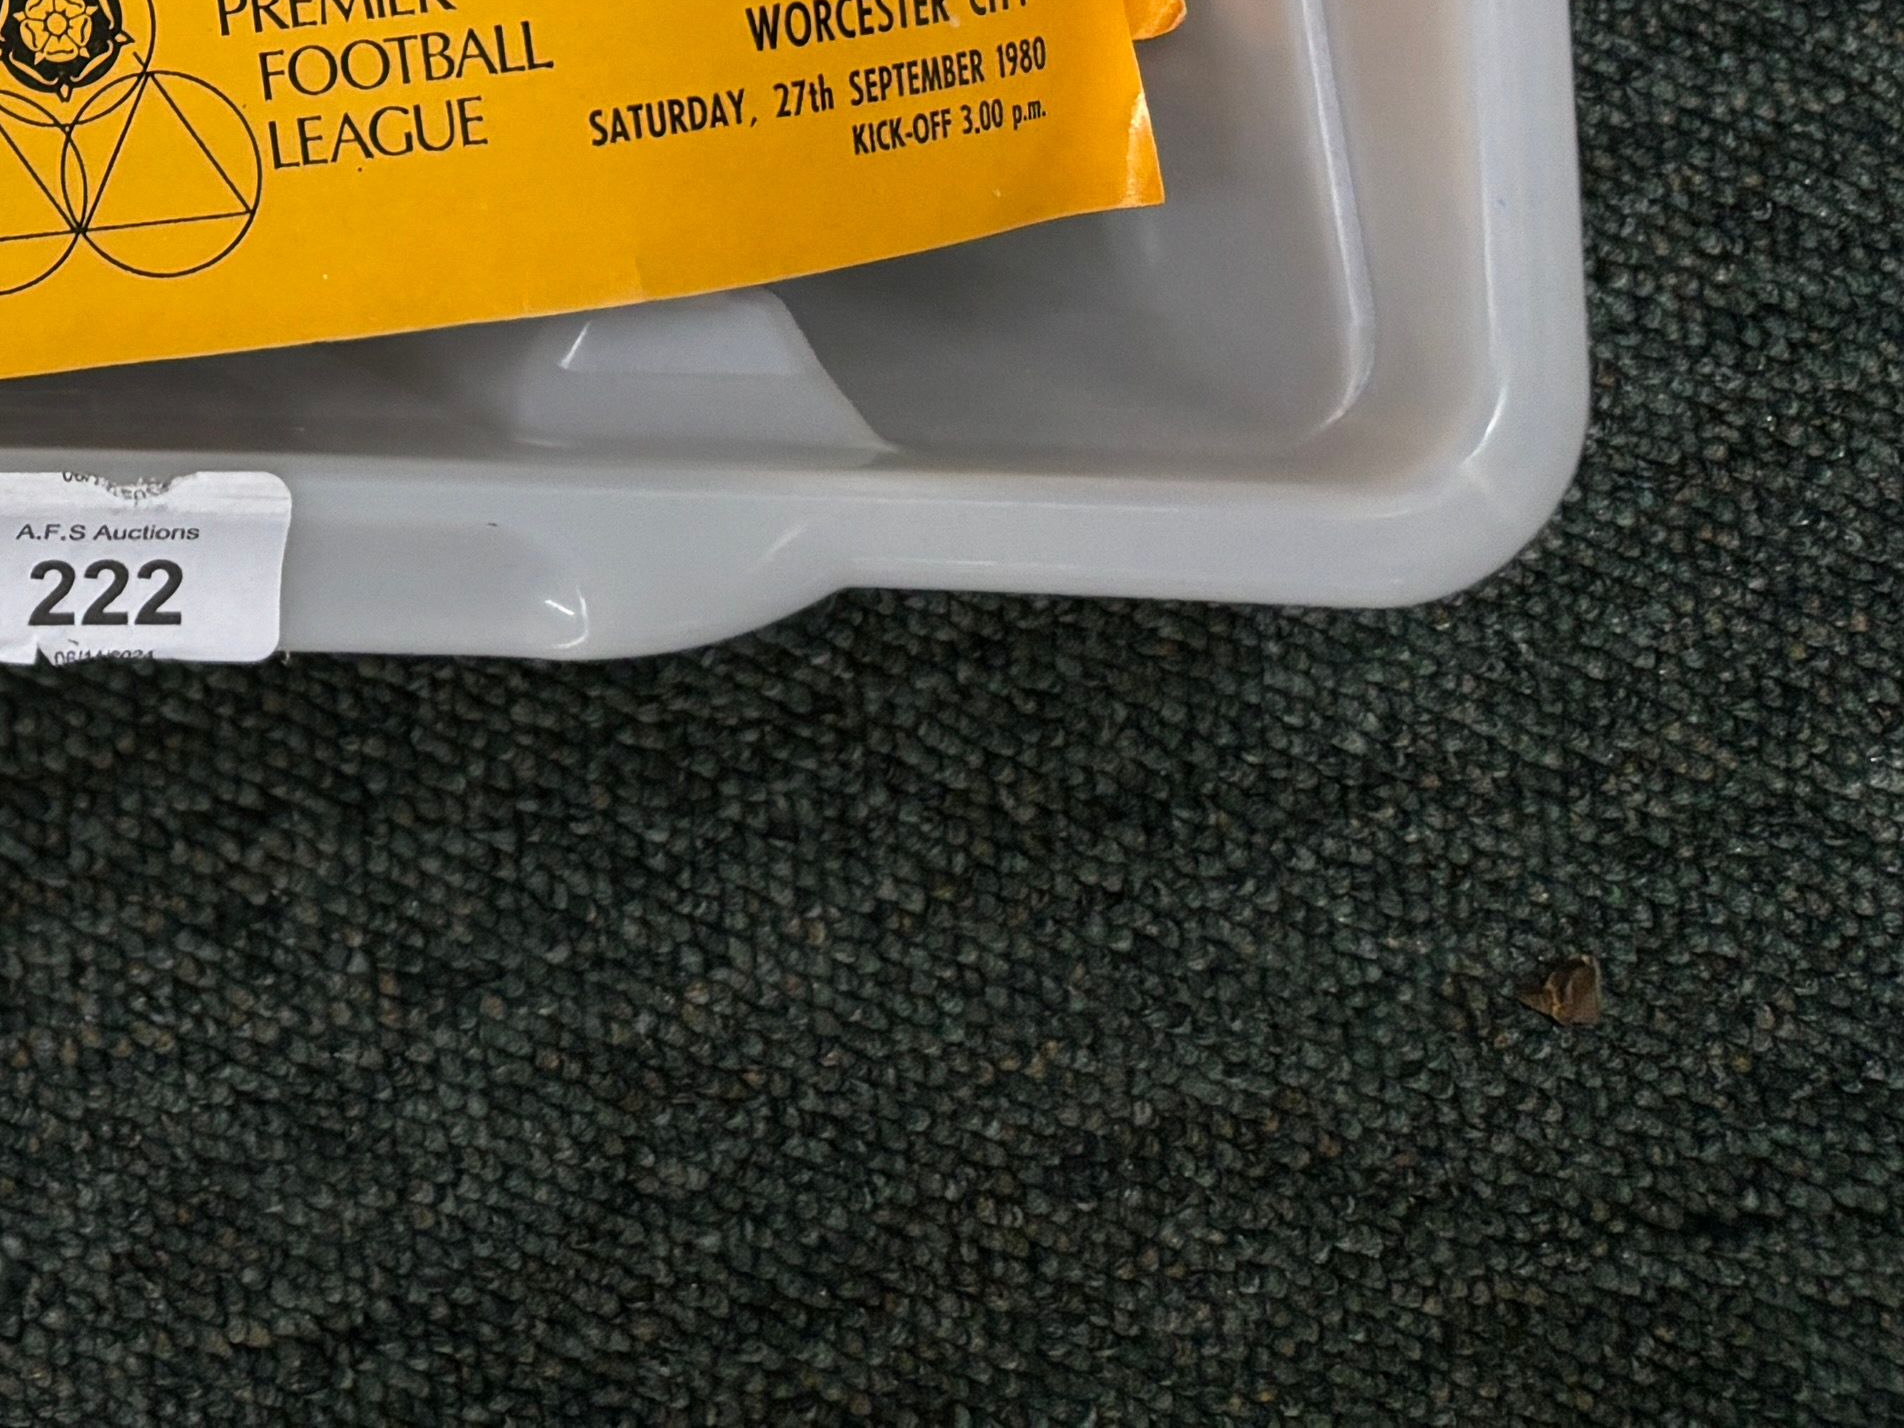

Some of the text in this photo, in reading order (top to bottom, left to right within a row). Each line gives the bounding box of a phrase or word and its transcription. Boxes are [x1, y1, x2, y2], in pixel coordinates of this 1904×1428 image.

[259, 21, 553, 100] FOOTBALL
[590, 37, 1046, 146] SATURDAY, 27th SEPTEMBER 1980
[269, 96, 488, 169] LEAGUE
[852, 99, 1046, 154] KICK-OFF 3.00 p.m.
[16, 524, 199, 540] A.F.S Auctions
[28, 560, 183, 626] 222
